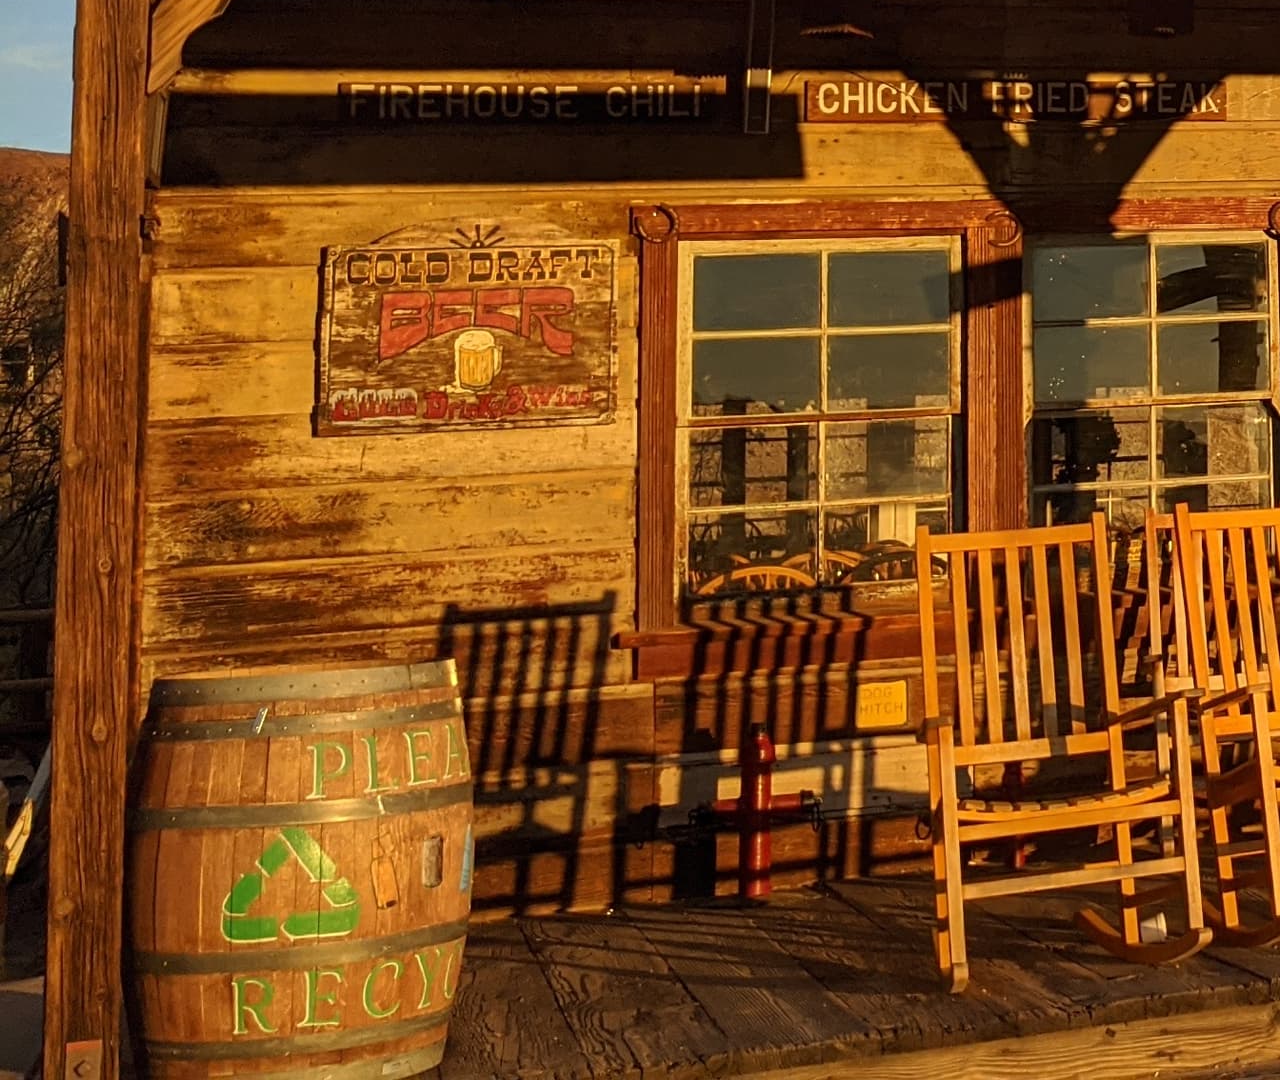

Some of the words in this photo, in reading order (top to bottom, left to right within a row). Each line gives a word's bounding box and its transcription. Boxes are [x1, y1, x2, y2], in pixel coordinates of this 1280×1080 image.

[350, 84, 578, 120] FIREHOUSE
[604, 83, 702, 119] CHILI
[816, 81, 969, 115] CHICKEN
[991, 81, 1088, 114] FRIED
[1114, 80, 1220, 115] STEAK
[346, 251, 450, 285] COLD
[467, 248, 600, 283] DRAFT
[378, 287, 575, 362] BEER
